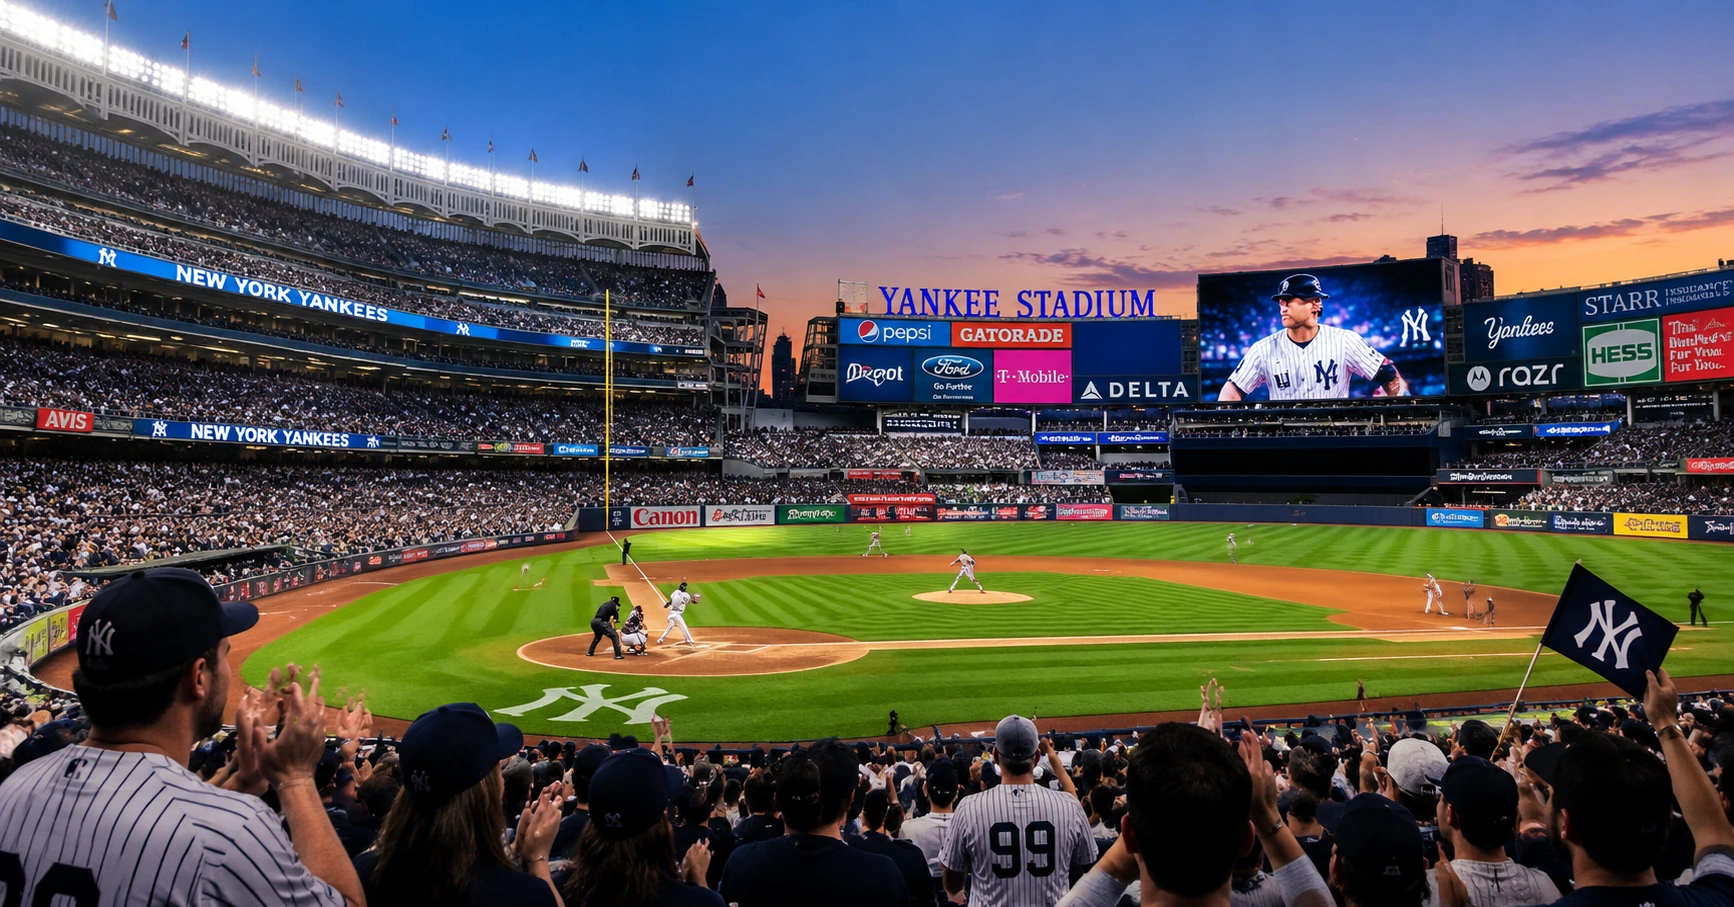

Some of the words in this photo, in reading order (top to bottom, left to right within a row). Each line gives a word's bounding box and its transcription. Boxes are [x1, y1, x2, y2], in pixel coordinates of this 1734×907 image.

[176, 265, 227, 290] NEW
[235, 277, 292, 304] YORK
[298, 290, 388, 323] YANKEES
[878, 286, 1001, 318] YANKEE
[1016, 289, 1156, 319] STADIUM
[1585, 289, 1662, 316] STARR
[883, 325, 932, 343] pepsi
[960, 327, 1064, 344] GATORADE
[1484, 315, 1554, 349] Yankees
[1591, 342, 1653, 364] HESS
[934, 382, 945, 391] Go
[1499, 364, 1564, 387] razr
[1109, 381, 1189, 398] DELTA
[45, 410, 87, 430] AVIS
[190, 423, 230, 441] NEW
[235, 426, 278, 444] YORK
[284, 430, 349, 448] YANKEES
[633, 507, 698, 526] Canon
[989, 821, 1055, 878] 99
